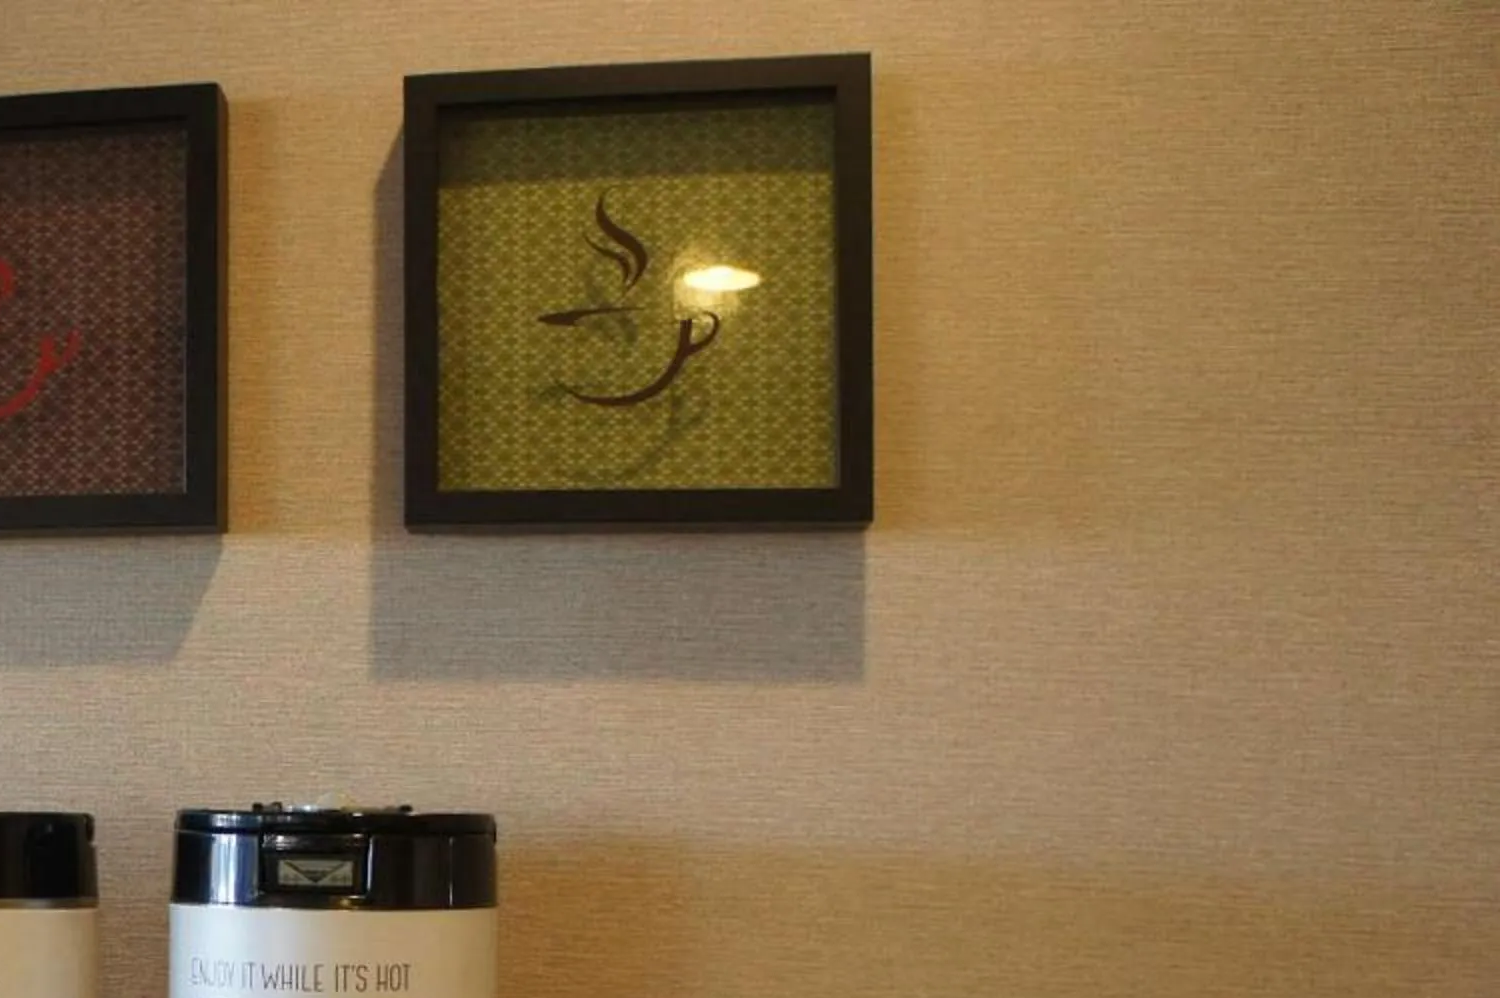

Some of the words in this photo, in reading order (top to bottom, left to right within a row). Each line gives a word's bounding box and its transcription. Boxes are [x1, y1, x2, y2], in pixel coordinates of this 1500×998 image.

[190, 957, 236, 987] ENJOY
[242, 961, 256, 989] IT
[260, 963, 324, 993] WHILE
[335, 964, 370, 993] IT'S
[376, 963, 411, 993] HOT
